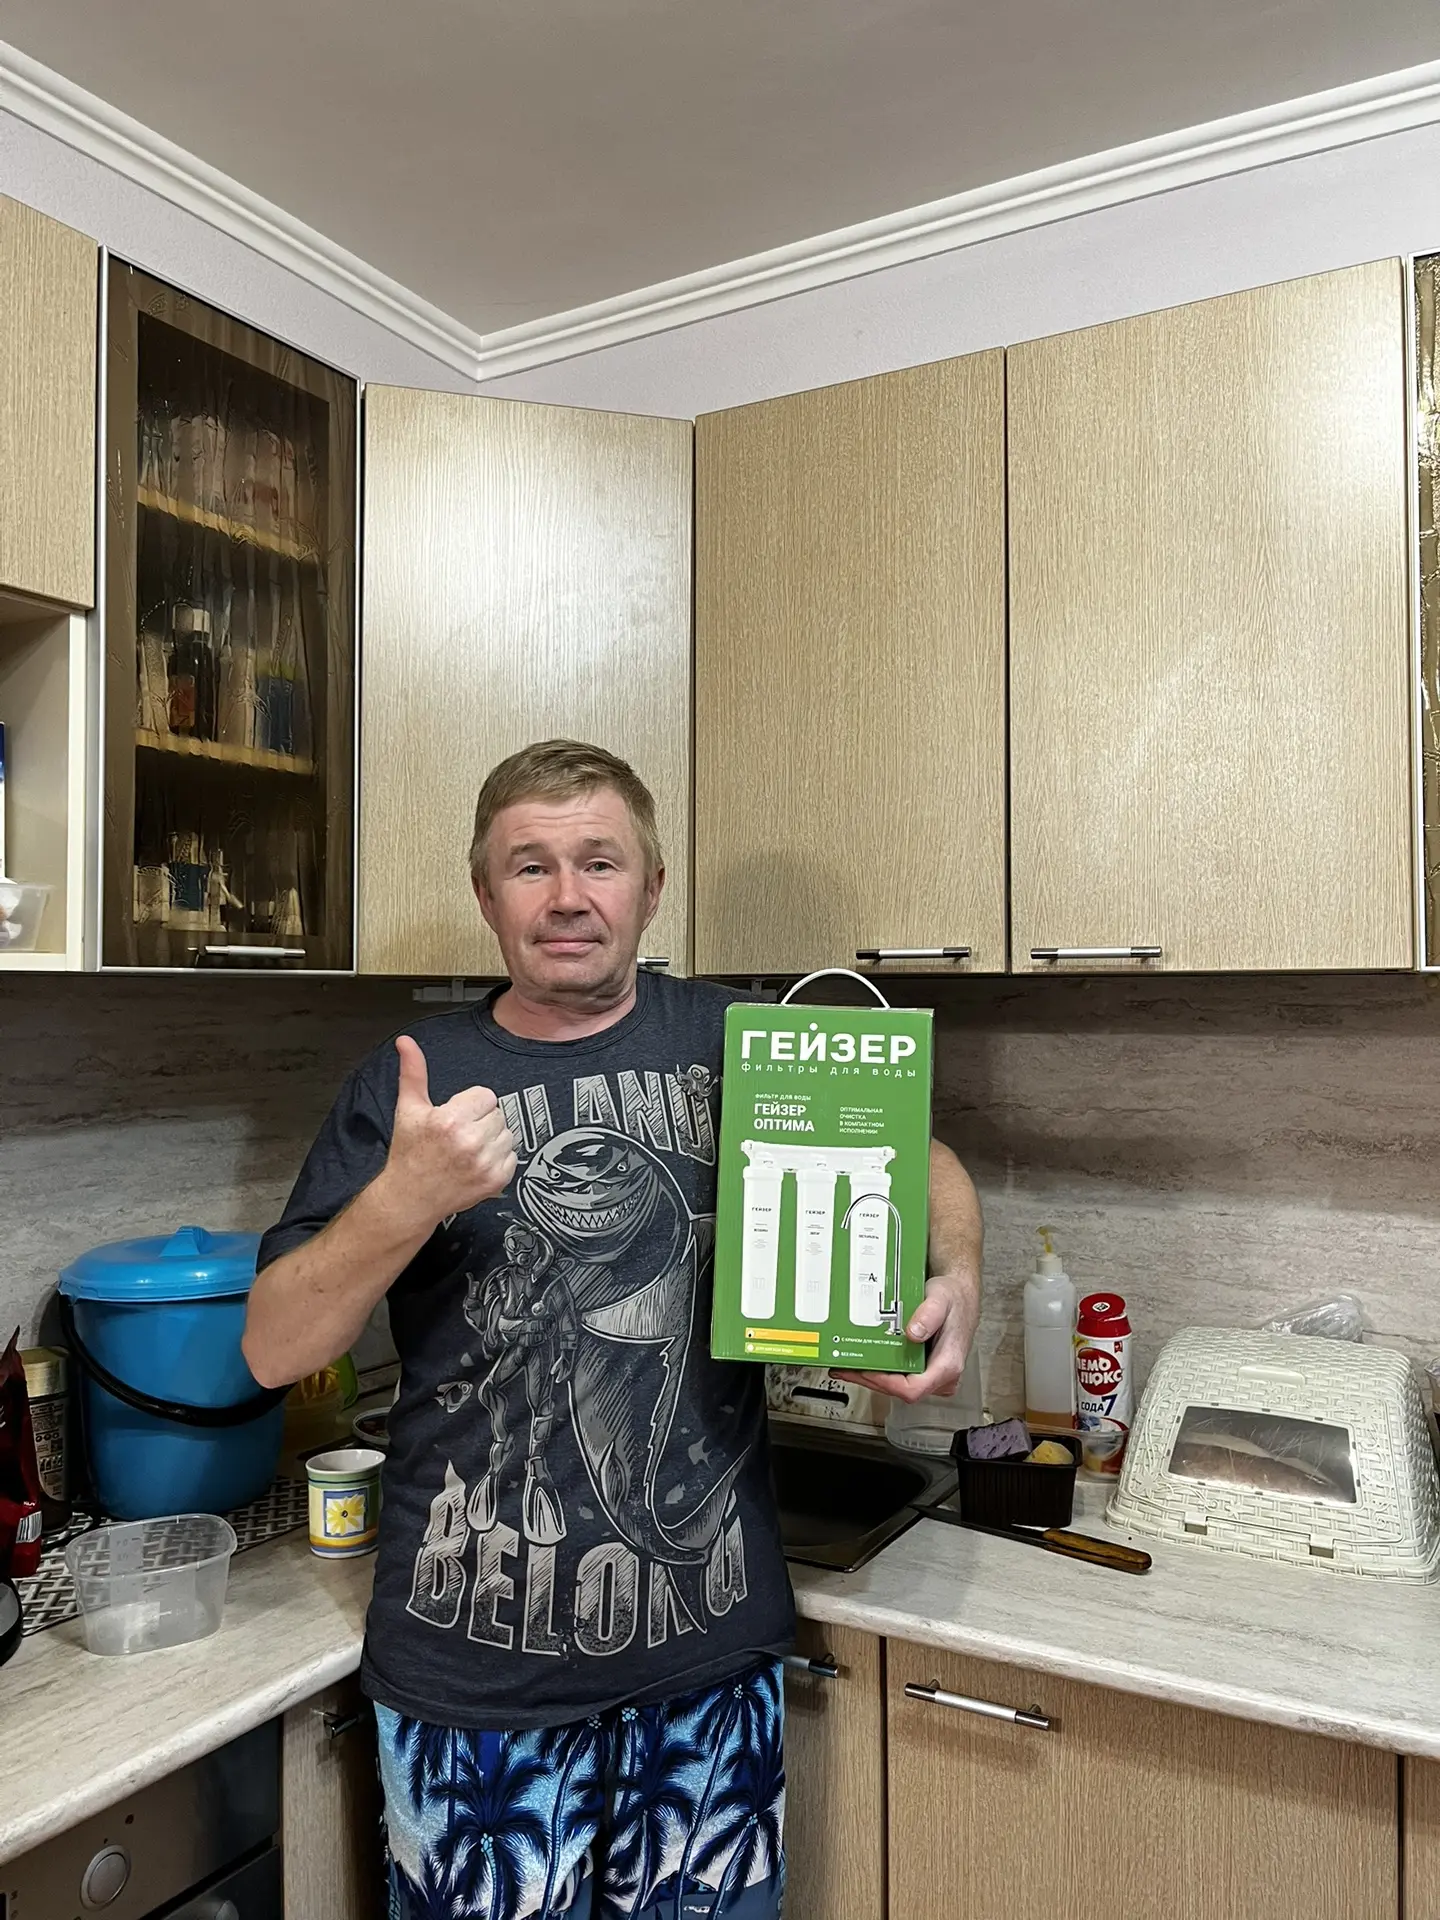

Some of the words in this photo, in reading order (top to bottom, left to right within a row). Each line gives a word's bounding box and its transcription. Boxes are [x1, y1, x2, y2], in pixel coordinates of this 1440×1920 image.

[741, 1022, 917, 1064] ГЕЙЗЕР
[741, 1061, 818, 1074] фильтры
[830, 1066, 860, 1075] для
[873, 1069, 916, 1078] воды
[754, 1101, 806, 1116] ГЕЙЗЕР
[753, 1118, 815, 1132] ОПТИМА
[1081, 1369, 1123, 1386] ЛЮКС
[1081, 1401, 1104, 1413] СОДА
[1101, 1394, 1118, 1416] 7
[405, 1460, 748, 1657] BELONG
